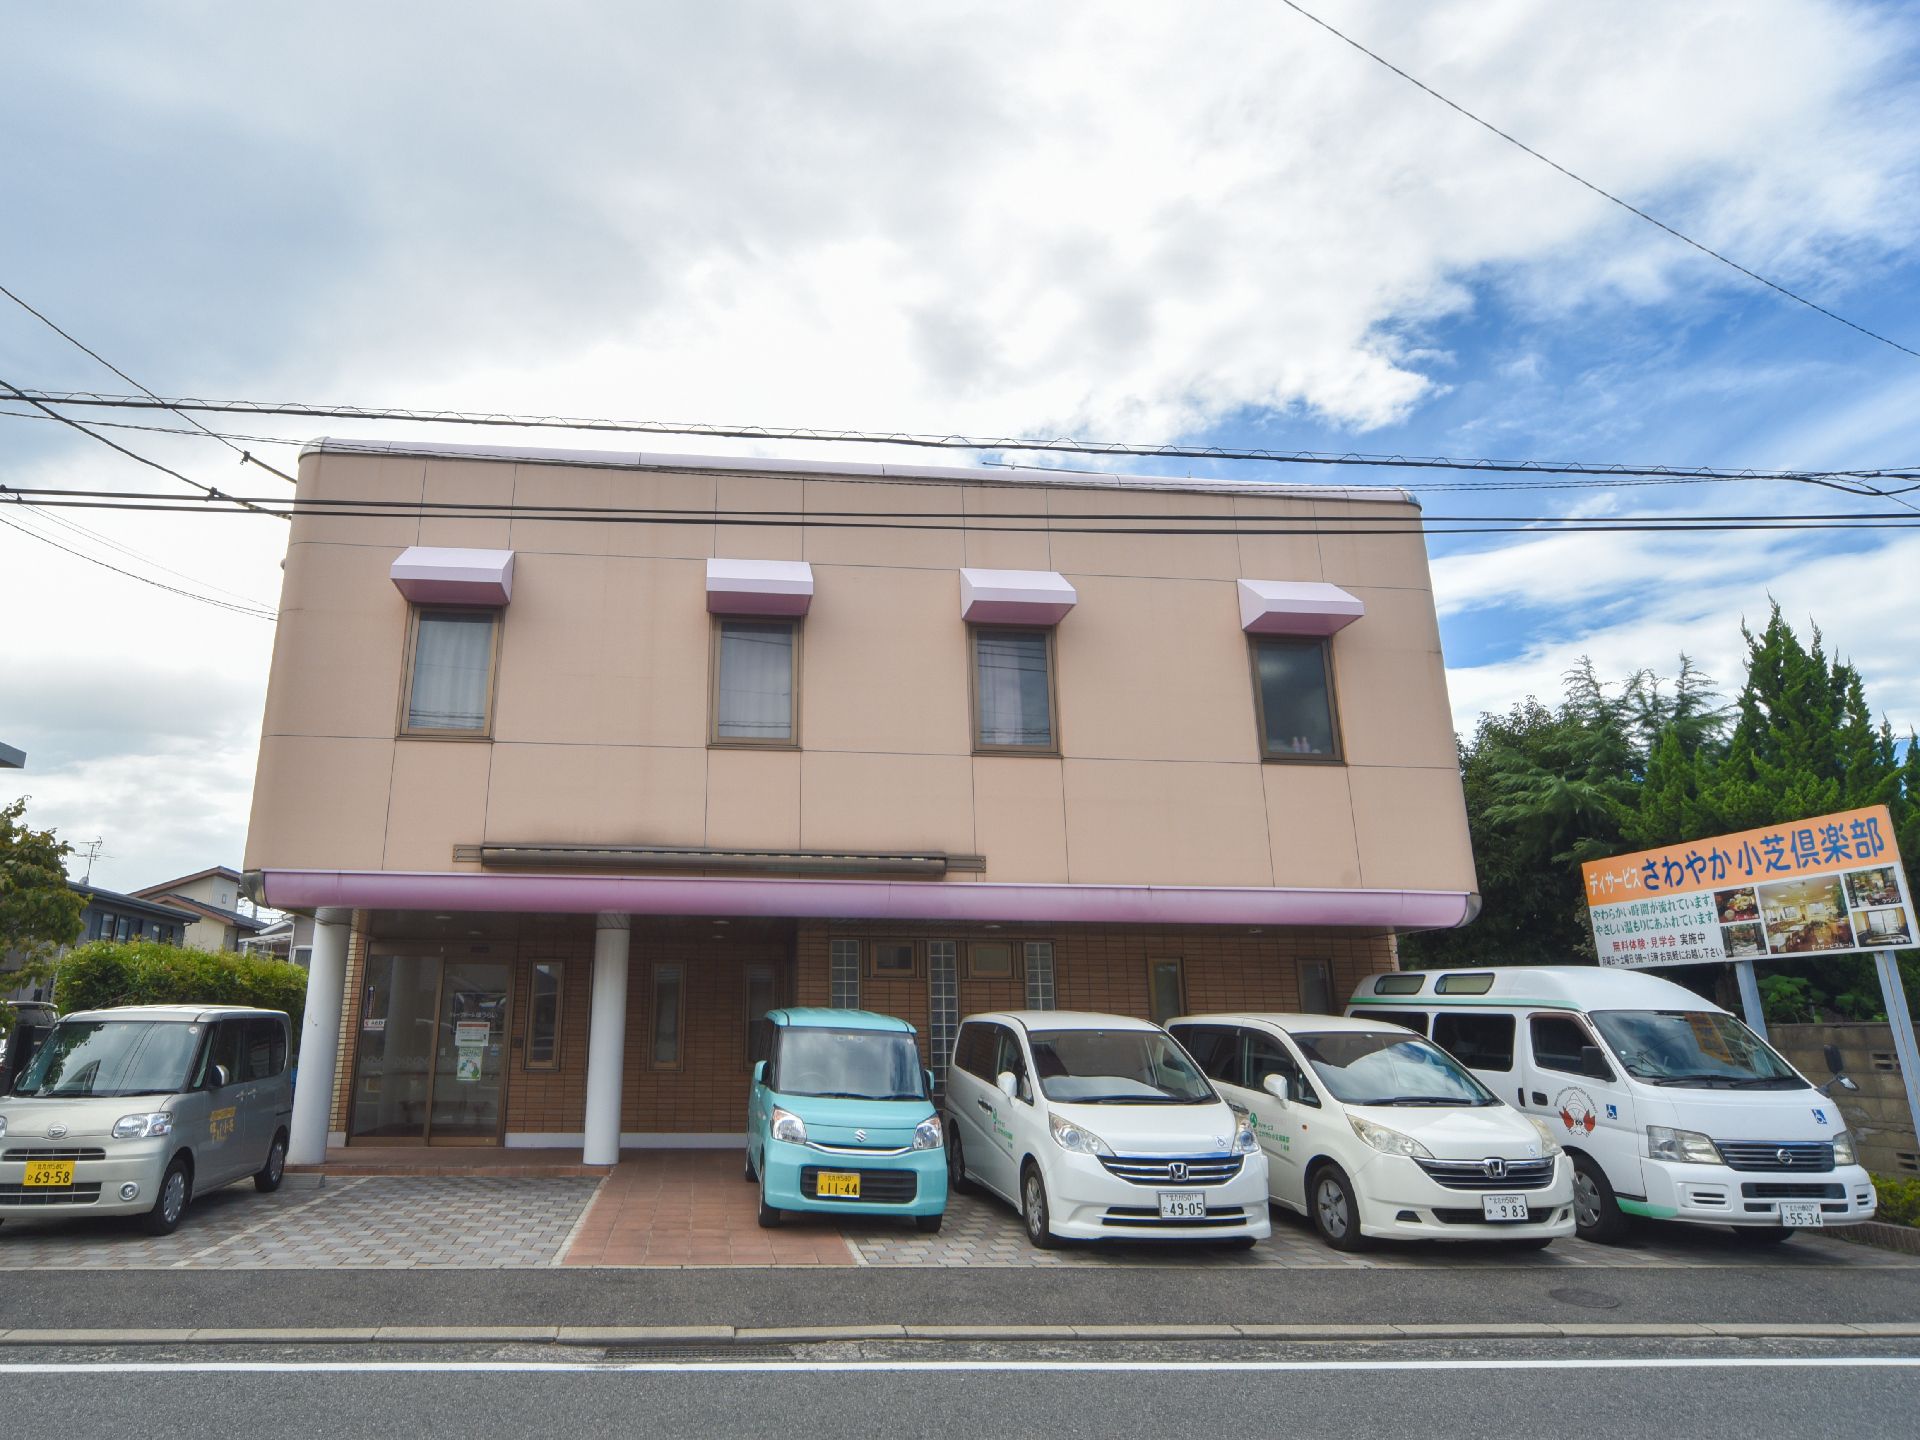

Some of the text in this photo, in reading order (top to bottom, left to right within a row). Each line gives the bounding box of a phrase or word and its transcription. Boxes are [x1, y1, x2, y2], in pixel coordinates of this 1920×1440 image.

[1642, 816, 1885, 891] さわやか小芝倶楽部
[1680, 932, 1706, 946] 実施中
[35, 1171, 70, 1183] 69-58
[828, 1182, 857, 1195] 11-44
[1170, 1203, 1203, 1215] 49-05
[1790, 1212, 1821, 1224] 55-34
